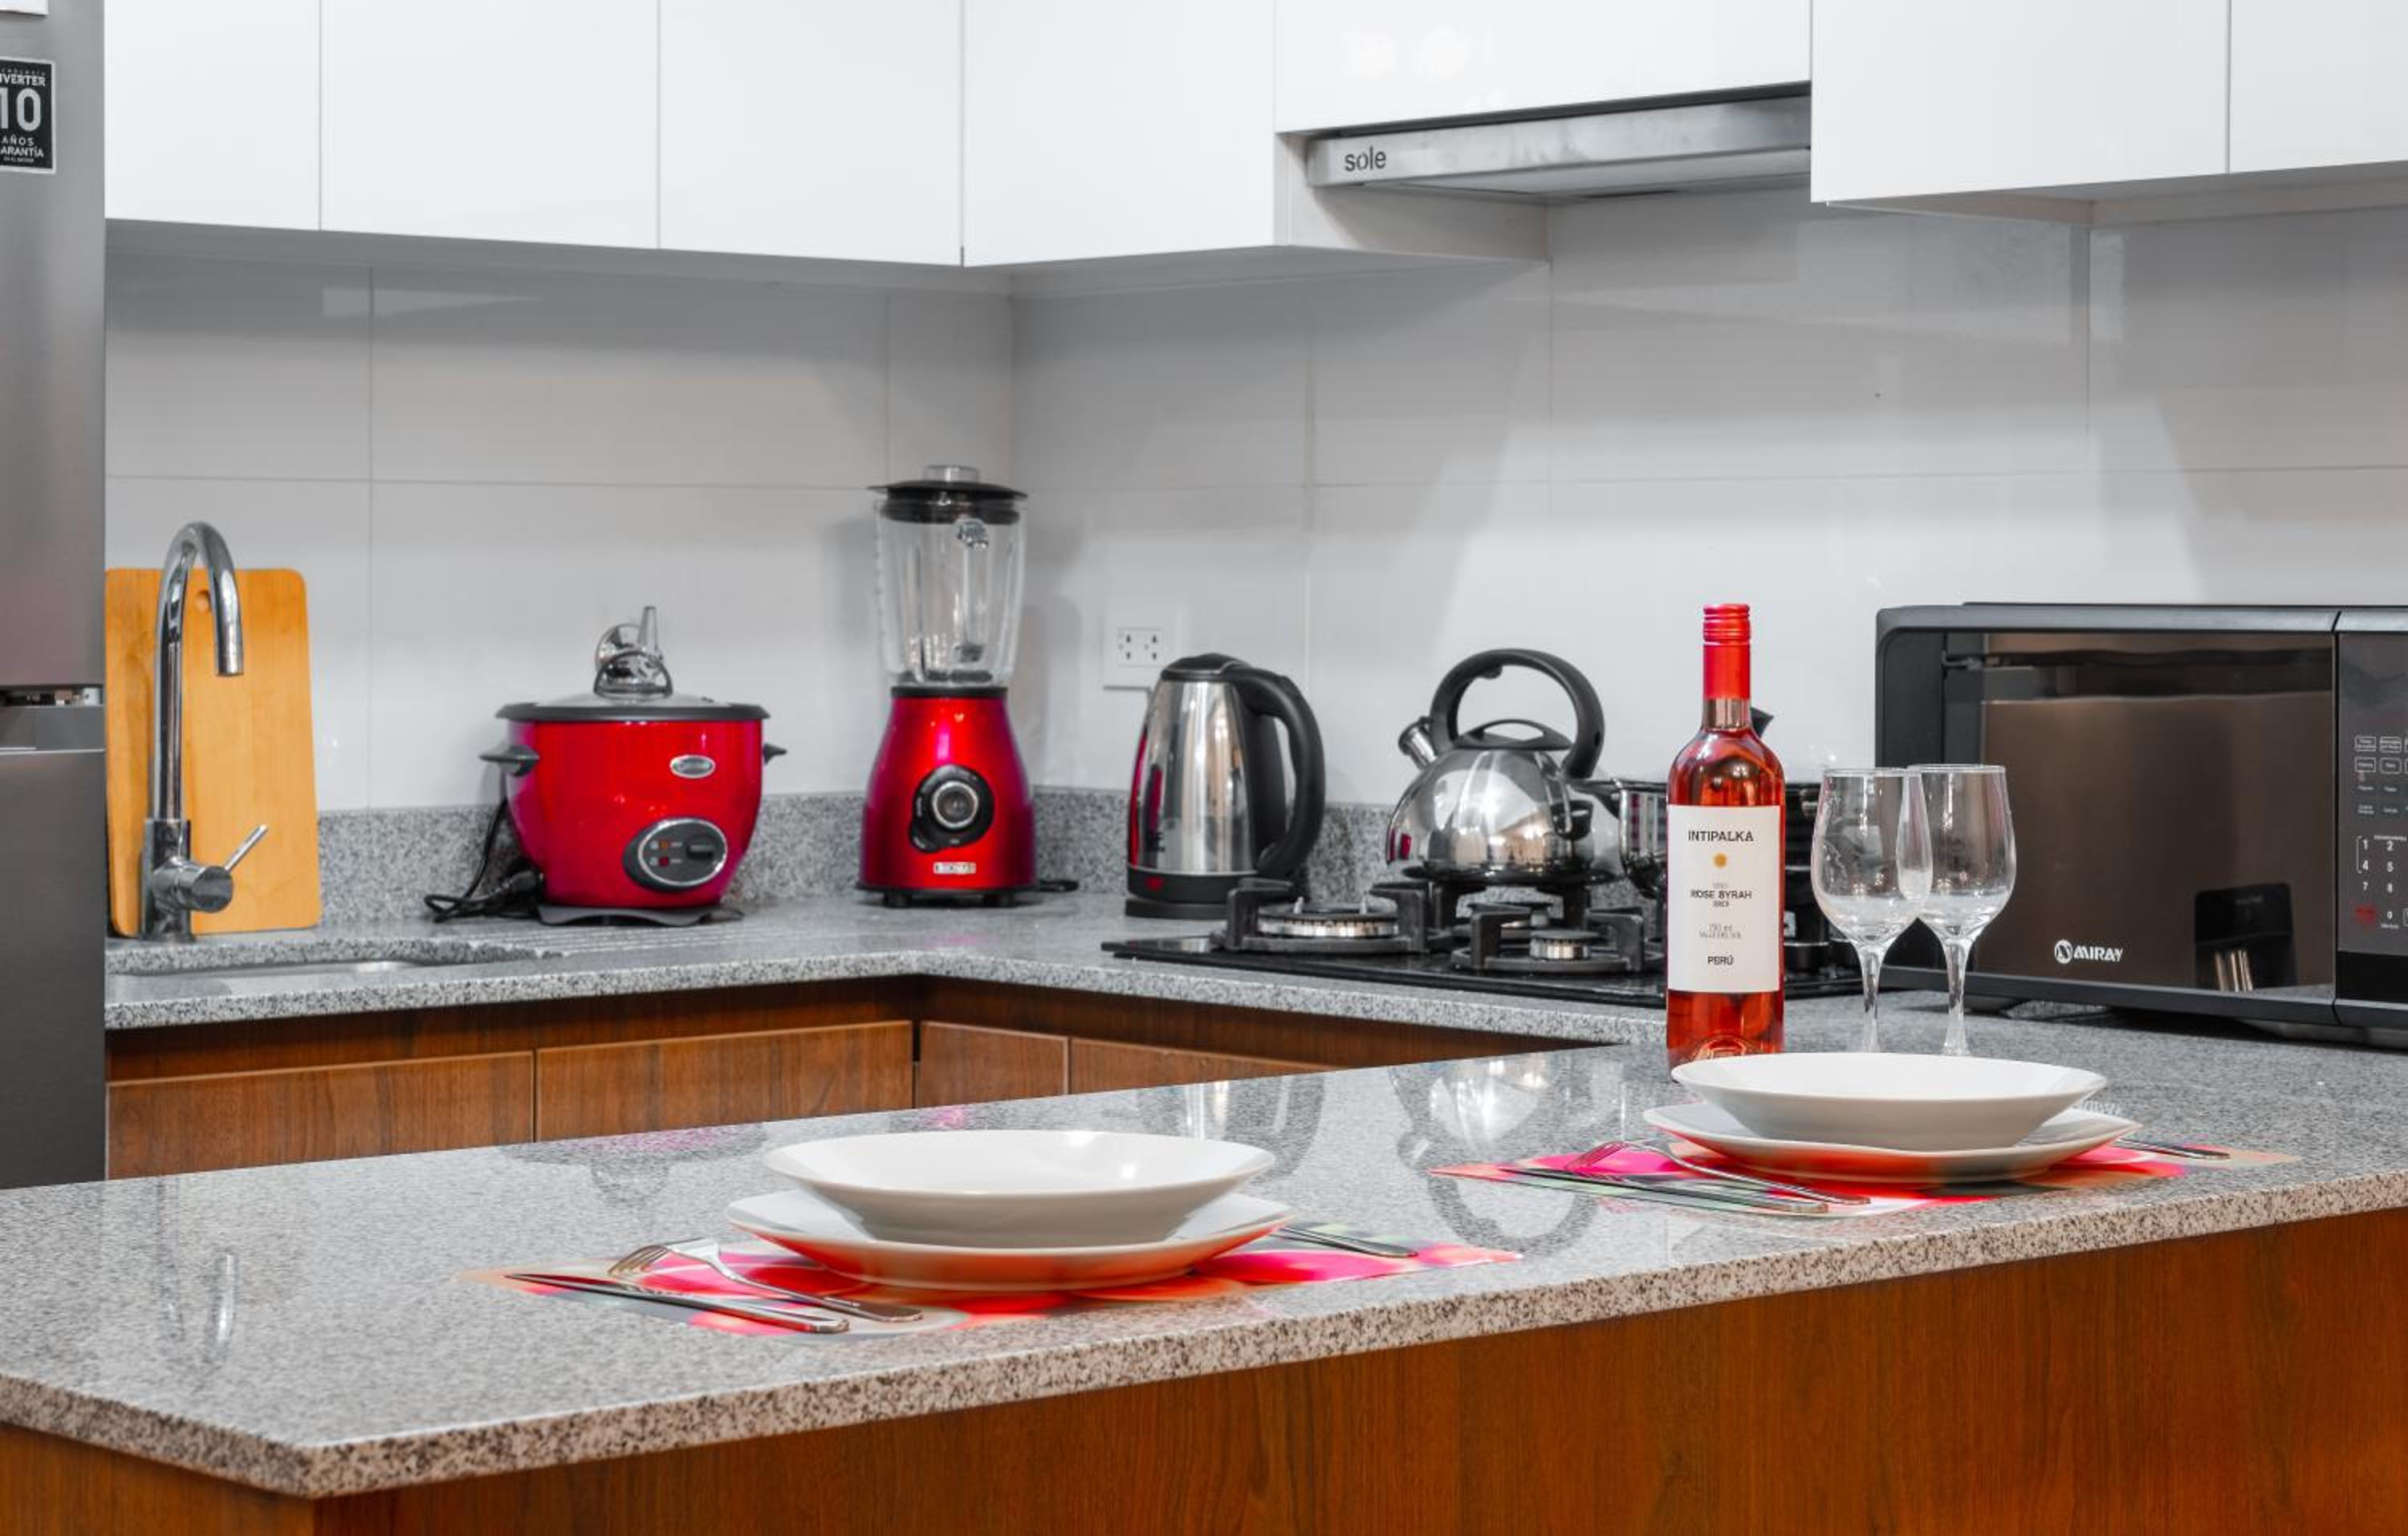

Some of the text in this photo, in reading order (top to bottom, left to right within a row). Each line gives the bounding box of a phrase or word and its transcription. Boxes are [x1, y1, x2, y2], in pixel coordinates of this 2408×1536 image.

[0, 87, 41, 131] 10
[1344, 145, 1386, 172] sole
[1688, 831, 1754, 842] INTIPALKA
[2362, 839, 2394, 851] 1 2
[2362, 859, 2369, 871] 4
[2073, 945, 2123, 962] MIRAY
